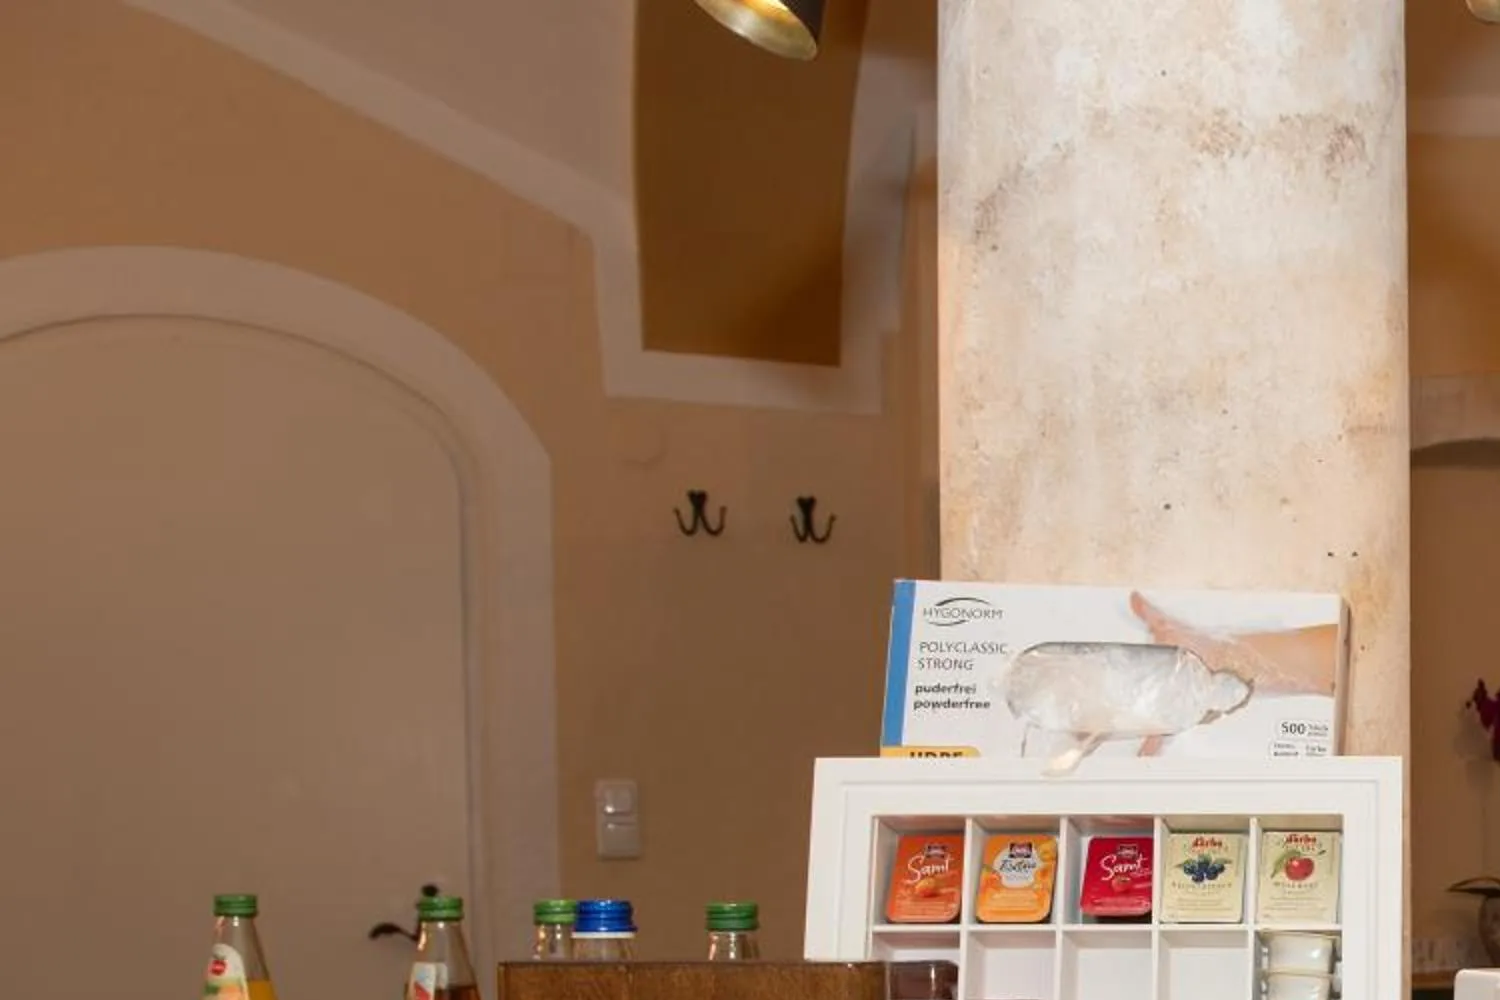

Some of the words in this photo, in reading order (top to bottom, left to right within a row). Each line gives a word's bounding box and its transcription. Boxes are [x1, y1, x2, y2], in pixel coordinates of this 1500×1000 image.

[923, 607, 1003, 620] HYGONORM
[919, 641, 1008, 655] POLYCLASSIC
[918, 657, 974, 671] STRONG
[915, 682, 976, 696] puderfrei
[913, 698, 990, 711] powderfree
[1281, 721, 1306, 735] 500
[904, 853, 954, 884] Samt
[1100, 853, 1147, 881] Samt
